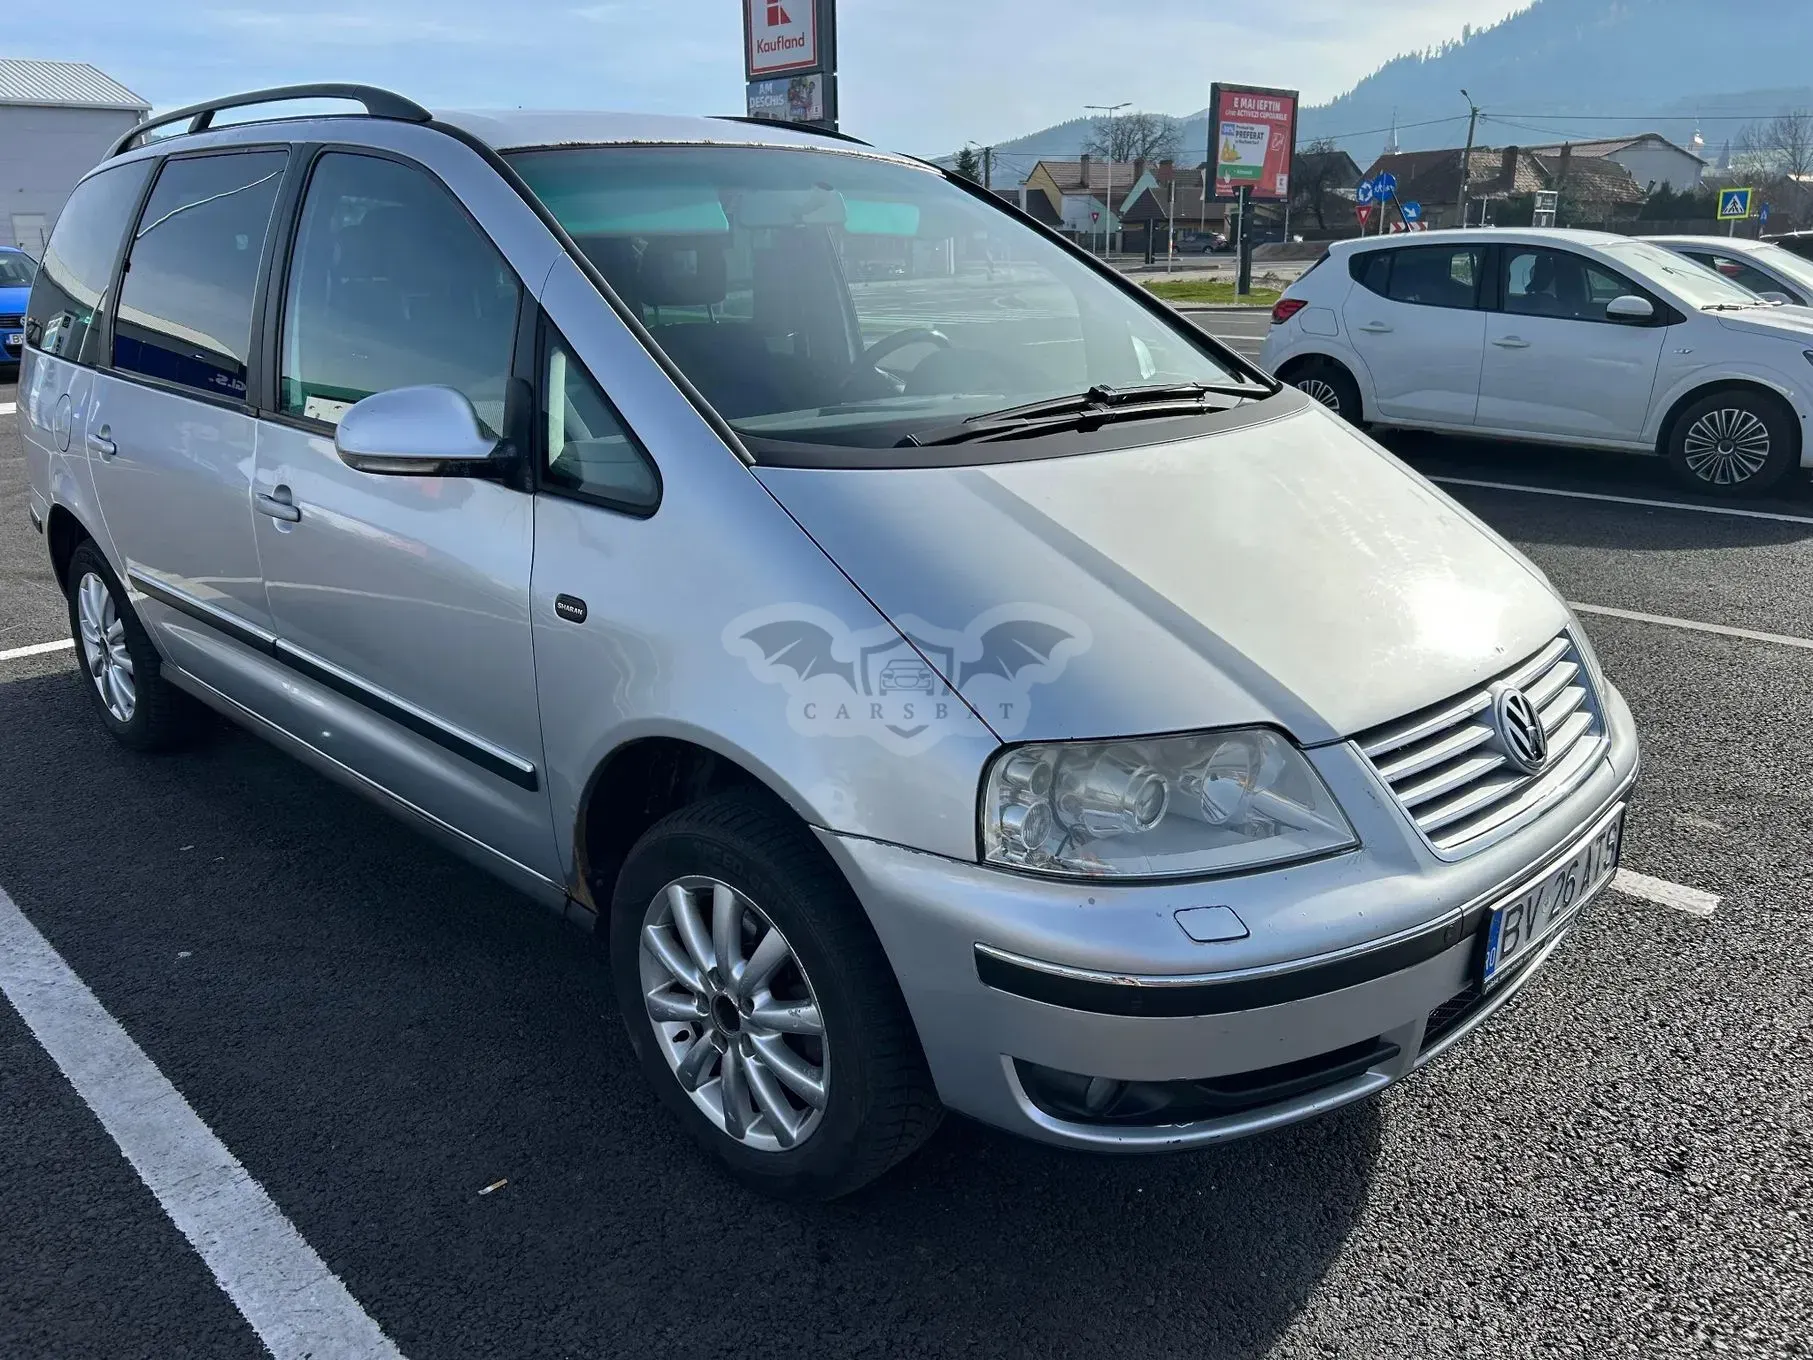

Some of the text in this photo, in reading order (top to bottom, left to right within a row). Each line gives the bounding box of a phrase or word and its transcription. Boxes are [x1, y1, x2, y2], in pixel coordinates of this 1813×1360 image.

[757, 32, 805, 53] Kaufland
[759, 83, 773, 94] AM
[749, 95, 784, 108] DESCHIS
[1233, 97, 1280, 112] E MAI IEFTIN
[1236, 130, 1264, 140] PREFERAT
[557, 602, 583, 615] SHARAN
[1501, 886, 1545, 957] BV
[1549, 859, 1579, 922] 26
